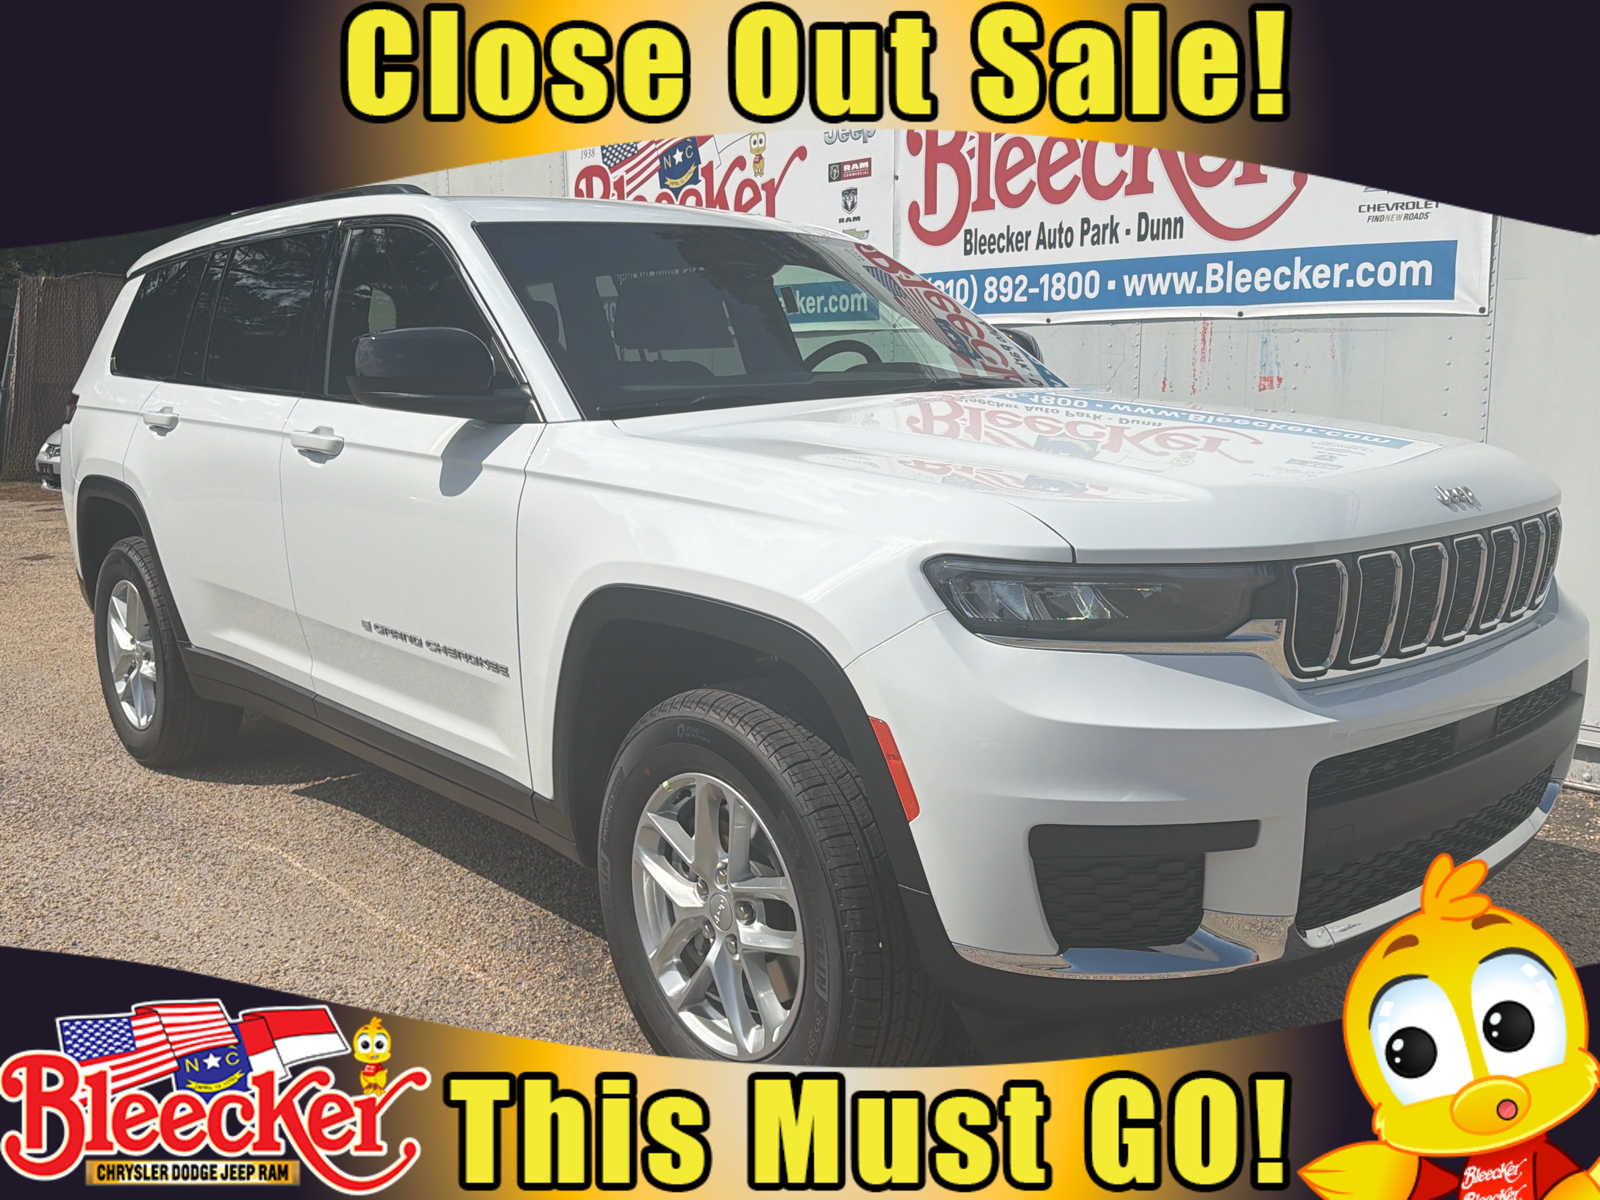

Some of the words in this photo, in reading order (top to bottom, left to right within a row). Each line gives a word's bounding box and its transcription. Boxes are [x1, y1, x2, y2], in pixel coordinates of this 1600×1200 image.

[843, 161, 869, 172] RAM
[1358, 201, 1439, 213] CHEVROLET
[963, 225, 1032, 256] Bleecker
[1035, 219, 1074, 251] Auto
[1080, 214, 1120, 247] Park
[1137, 212, 1184, 242] Dunn
[984, 269, 1100, 304] 892-1800
[1122, 257, 1433, 297] www.Bleecker.com
[373, 623, 423, 648] GRAND
